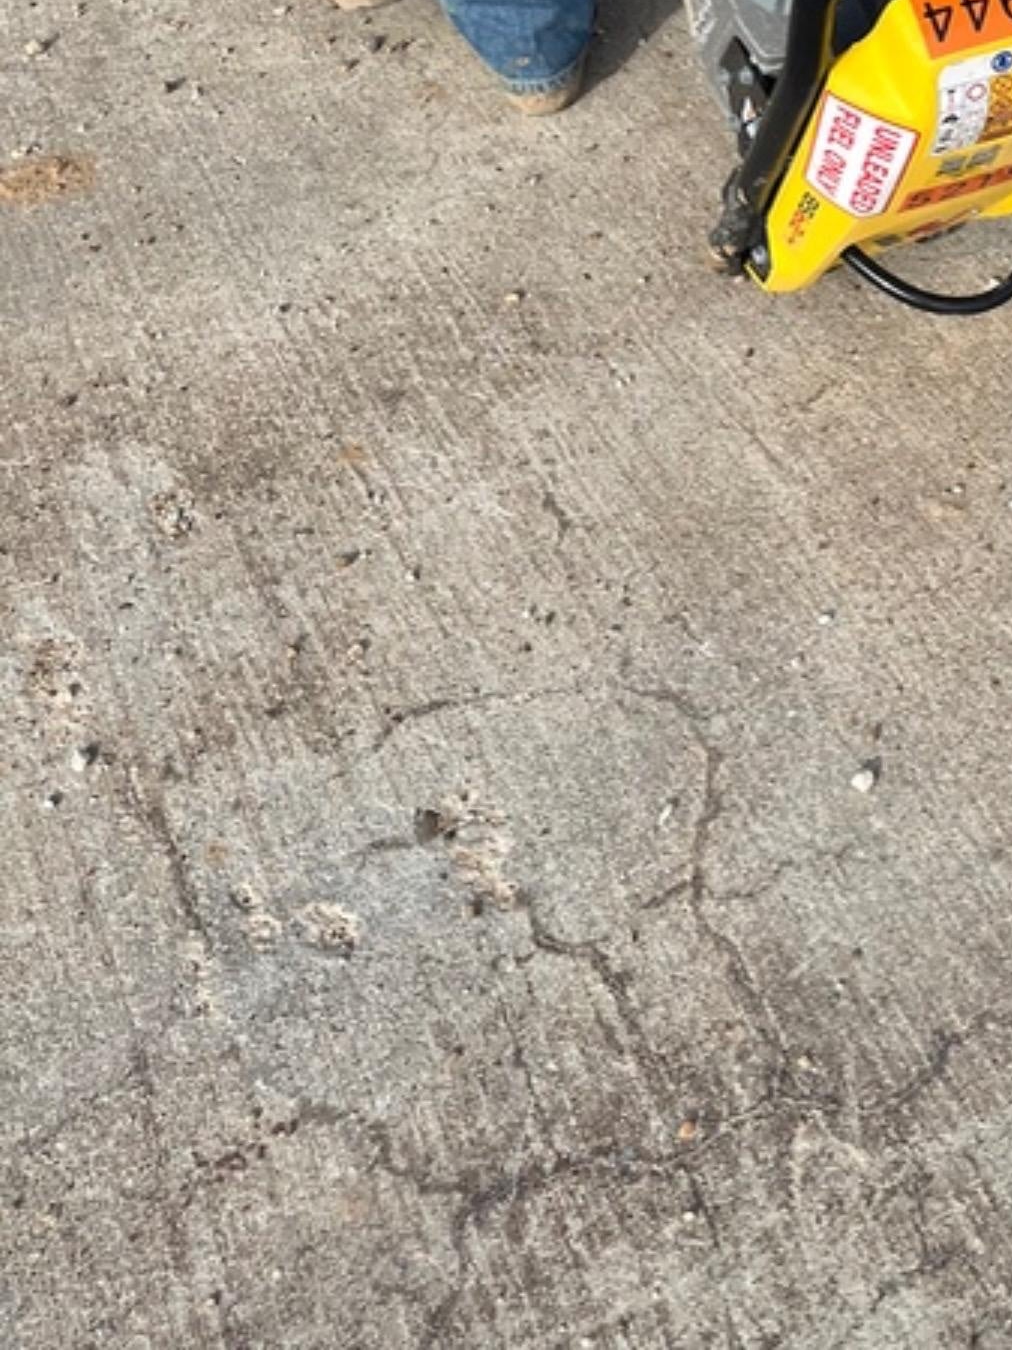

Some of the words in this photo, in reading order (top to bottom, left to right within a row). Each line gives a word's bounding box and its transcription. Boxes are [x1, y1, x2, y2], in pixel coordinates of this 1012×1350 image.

[827, 104, 862, 151] FUEL
[815, 149, 847, 198] ONLY
[850, 126, 902, 213] UNLEADED
